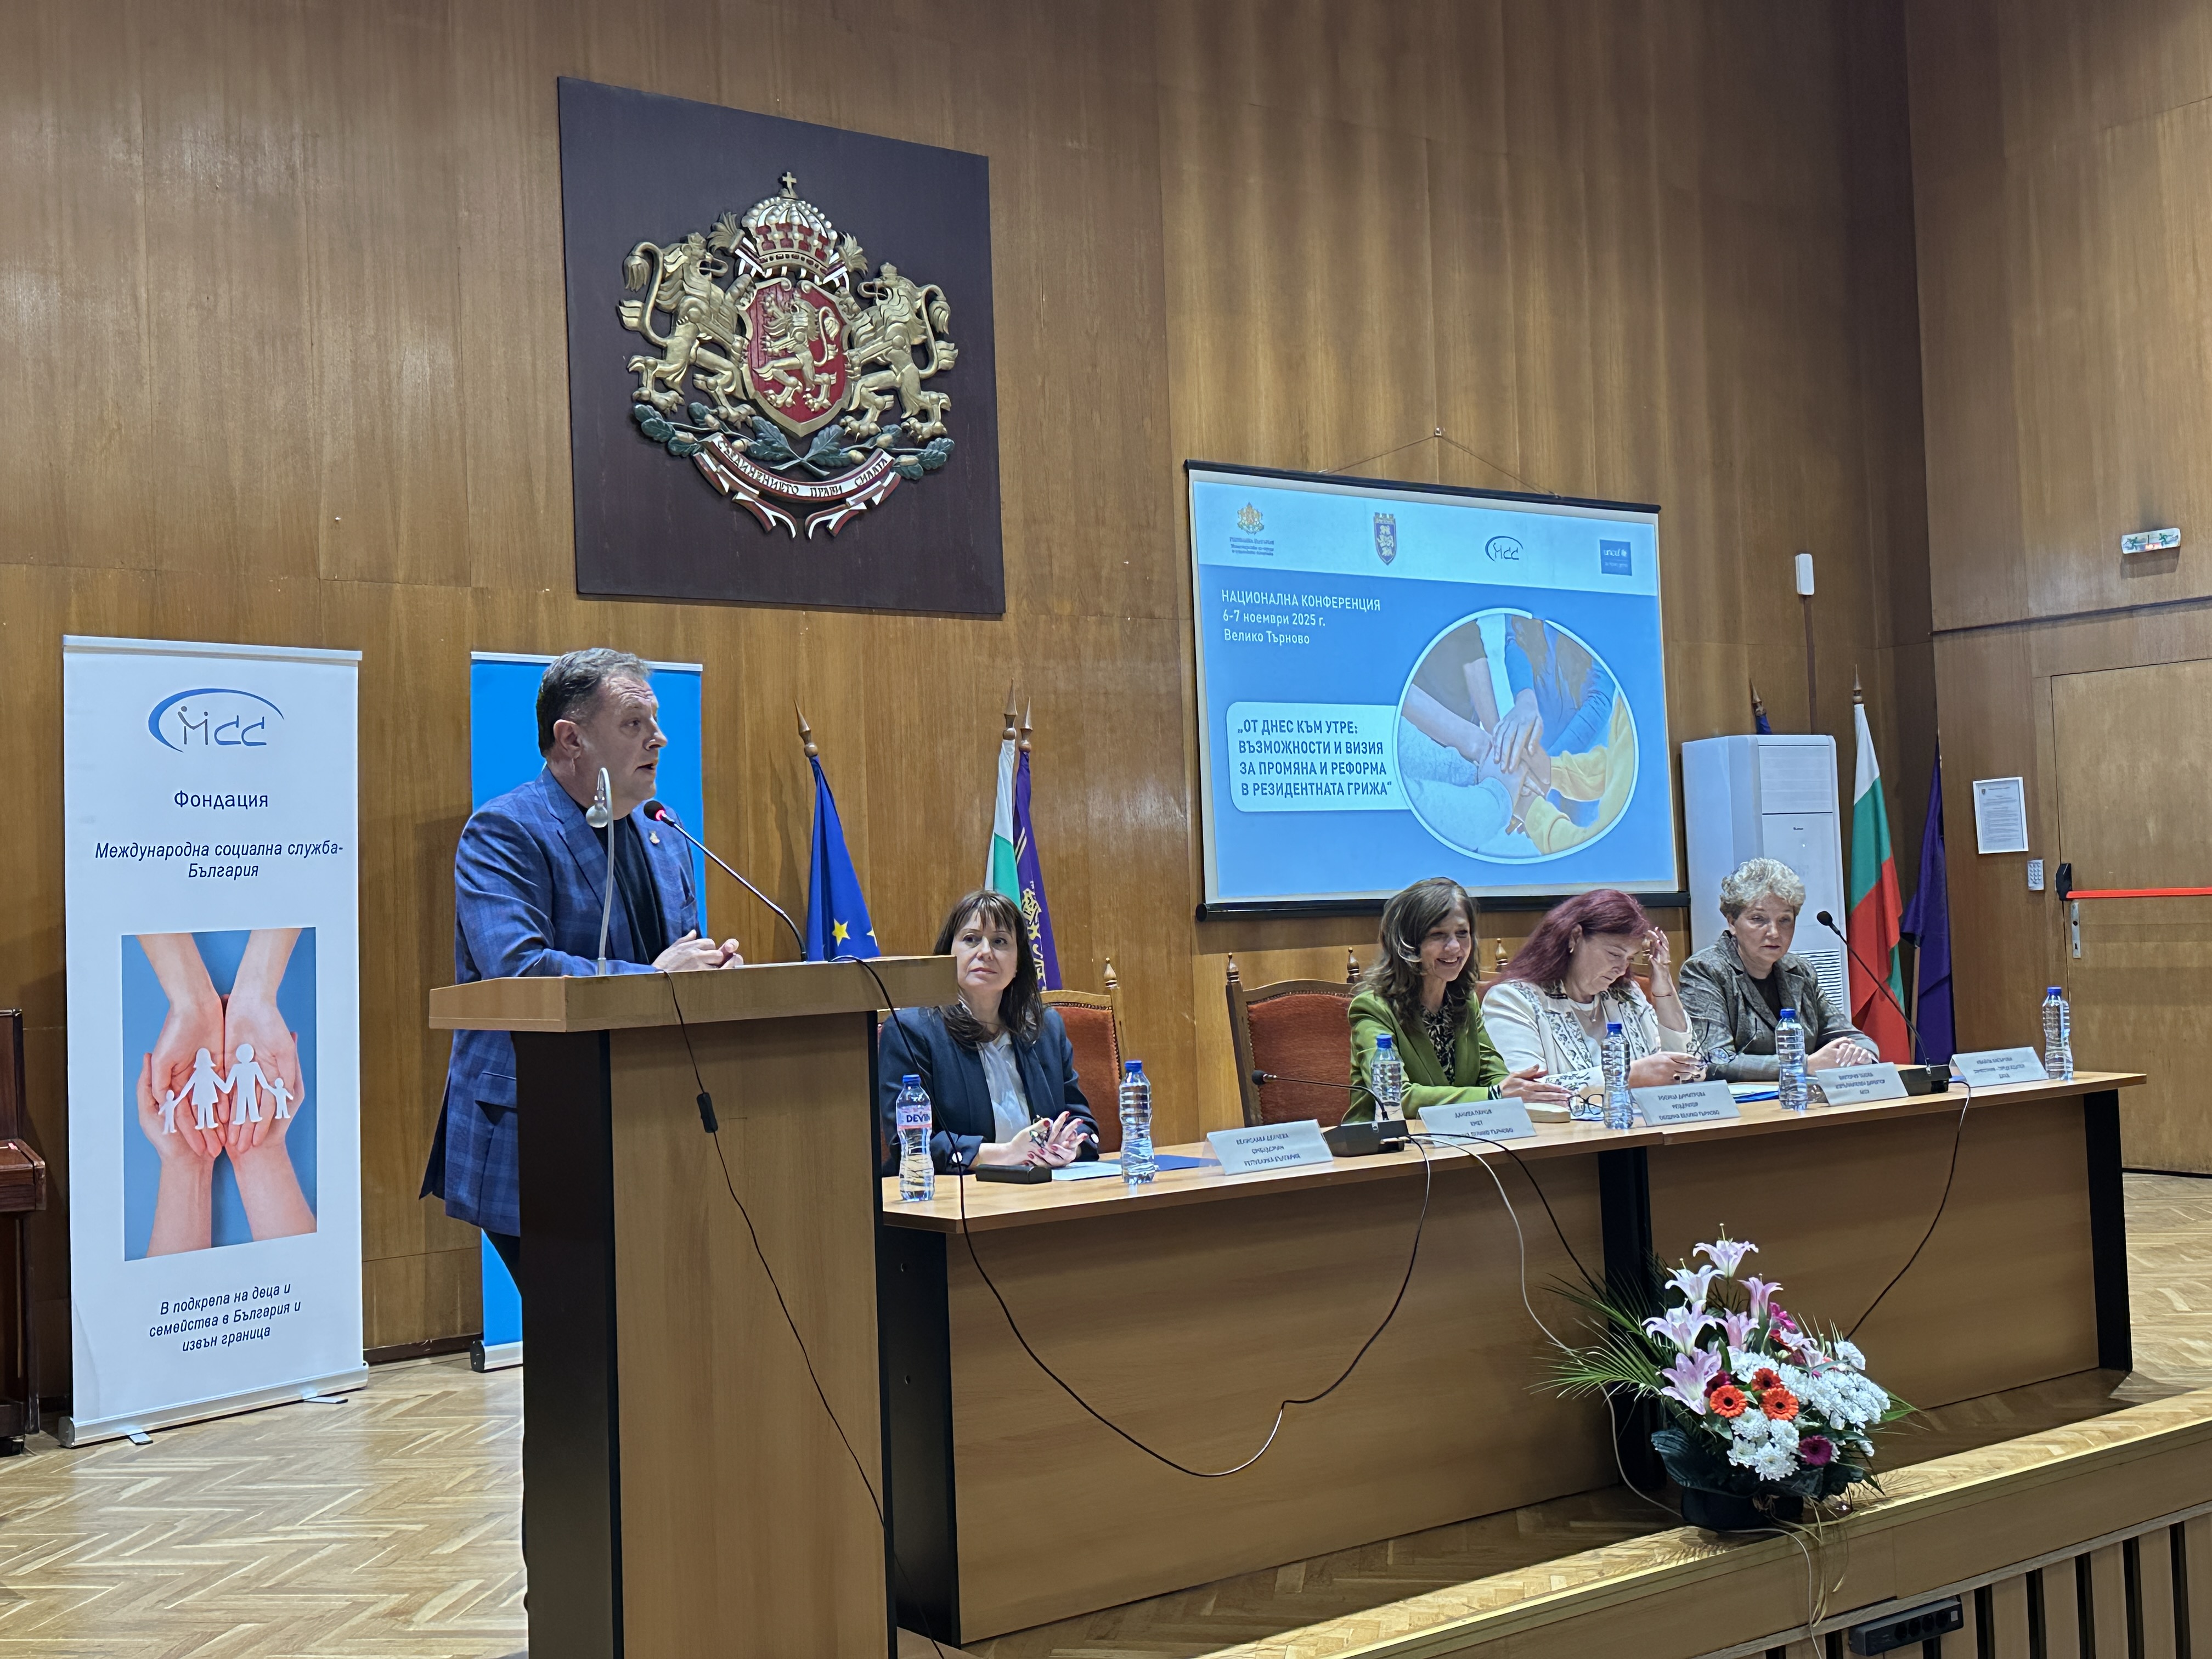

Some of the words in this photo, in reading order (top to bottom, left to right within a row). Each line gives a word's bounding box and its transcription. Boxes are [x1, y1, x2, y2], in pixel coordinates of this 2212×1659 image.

[1222, 589, 1299, 606] НАЦИОНАЛНА
[1301, 595, 1380, 612] КОНФЕРЕНЦИЯ
[1223, 609, 1240, 622] 6-7
[1243, 613, 1289, 627] ноември
[1292, 613, 1316, 626] 2025
[1319, 617, 1325, 627] г.
[1224, 628, 1263, 642] Велико
[1266, 630, 1310, 646] Търново
[1261, 719, 1294, 736] ДНЕС
[1296, 720, 1323, 734] КЪМ
[1325, 720, 1358, 734] УТРЕ:
[1239, 740, 1330, 754] ВЪЗМОЖНОСТИ
[1334, 741, 1342, 754] И
[1345, 741, 1383, 755] ВИЗИЯ
[1239, 761, 1256, 775] ЗА
[1259, 761, 1317, 775] ПРОМЯНА
[1319, 761, 1328, 775] И
[1331, 761, 1387, 775] РЕФОРМА
[1242, 783, 1249, 796] В
[1252, 782, 1345, 799] РЕЗИДЕНТНАТА
[174, 790, 268, 810] Фондация
[95, 842, 210, 862] Международна
[215, 844, 282, 859] социална
[287, 840, 343, 857] служба-
[188, 863, 258, 881] България
[160, 1301, 169, 1315] В
[173, 1294, 230, 1313] подкрепа
[234, 1291, 248, 1303] на
[252, 1286, 280, 1300] деца
[284, 1284, 291, 1294] и
[149, 1316, 218, 1339] семейства
[222, 1314, 229, 1324] в
[233, 1301, 290, 1323] България
[294, 1301, 301, 1312] и
[182, 1336, 218, 1352] извън
[221, 1327, 270, 1347] граница
